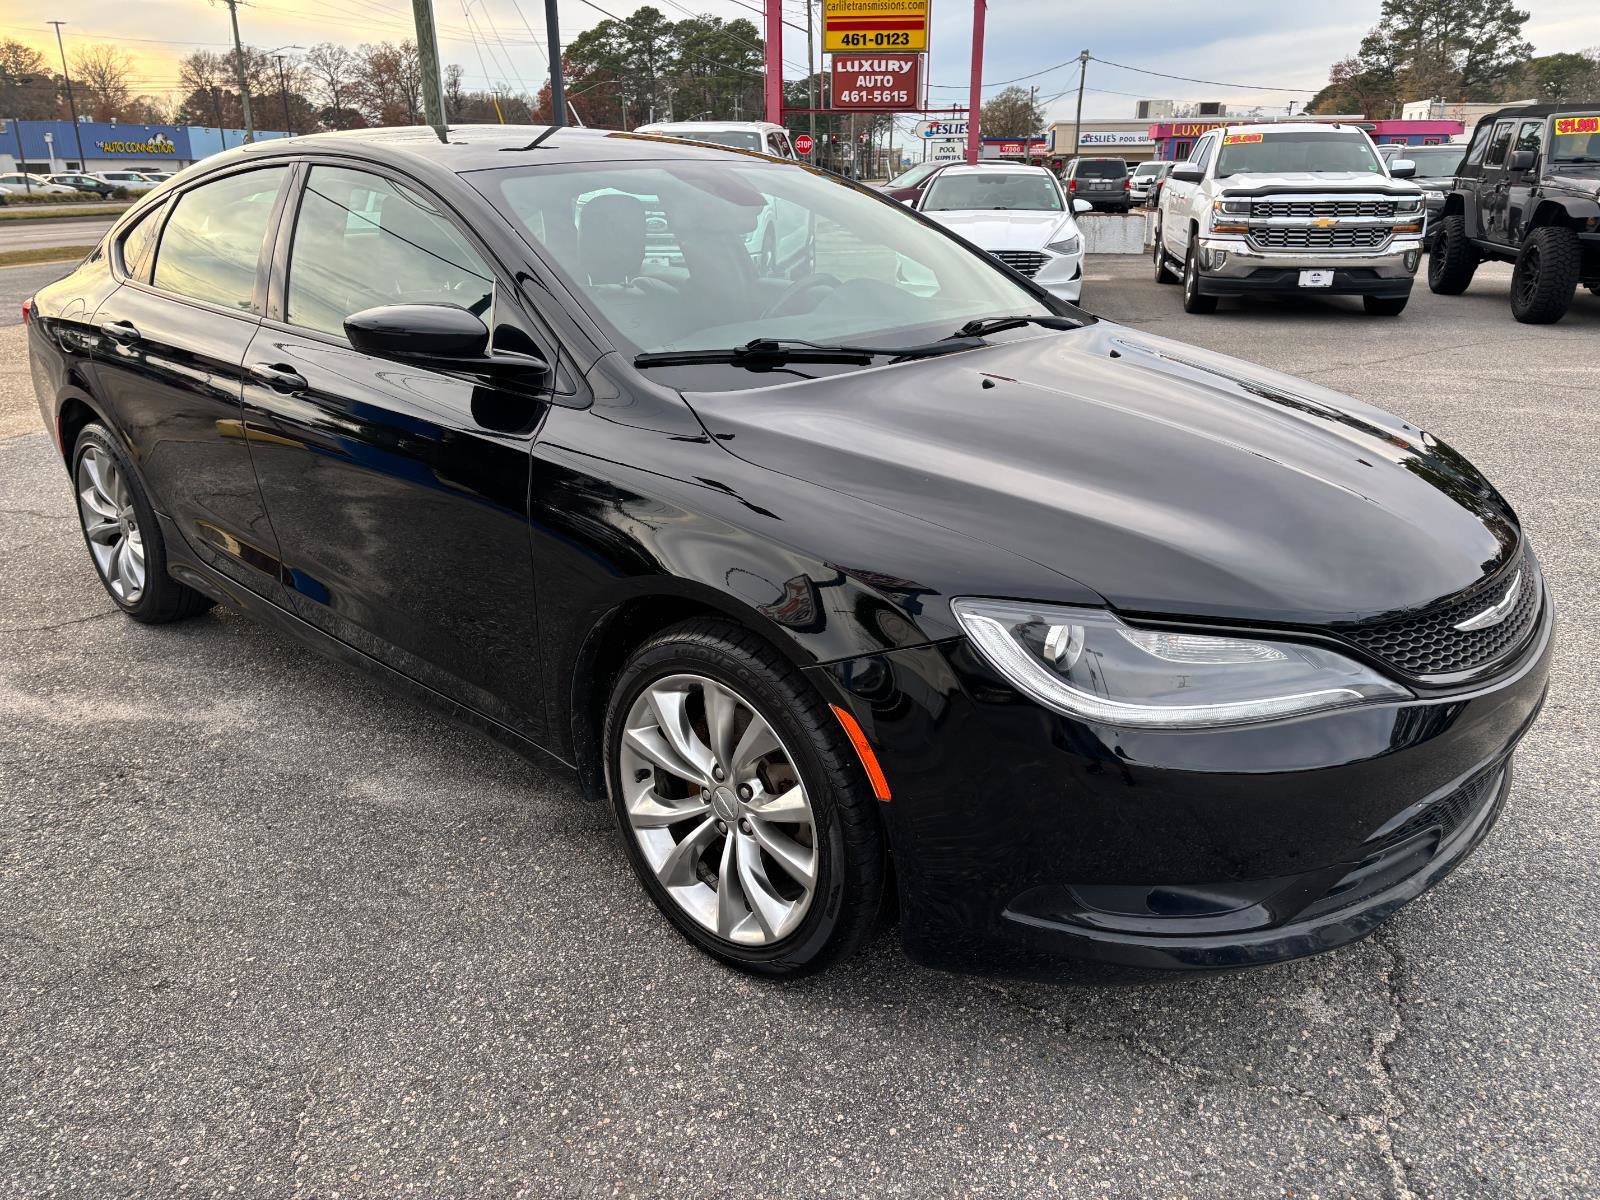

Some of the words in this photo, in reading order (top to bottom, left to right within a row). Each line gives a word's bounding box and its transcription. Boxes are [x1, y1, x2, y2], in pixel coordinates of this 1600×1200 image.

[841, 32, 910, 46] 461-0123
[837, 60, 913, 74] LUXURY
[856, 75, 894, 87] AUTO
[841, 90, 908, 102] 461-5615
[104, 142, 125, 153] AUTO
[125, 142, 175, 153] CONNECTION
[796, 140, 812, 149] STOP
